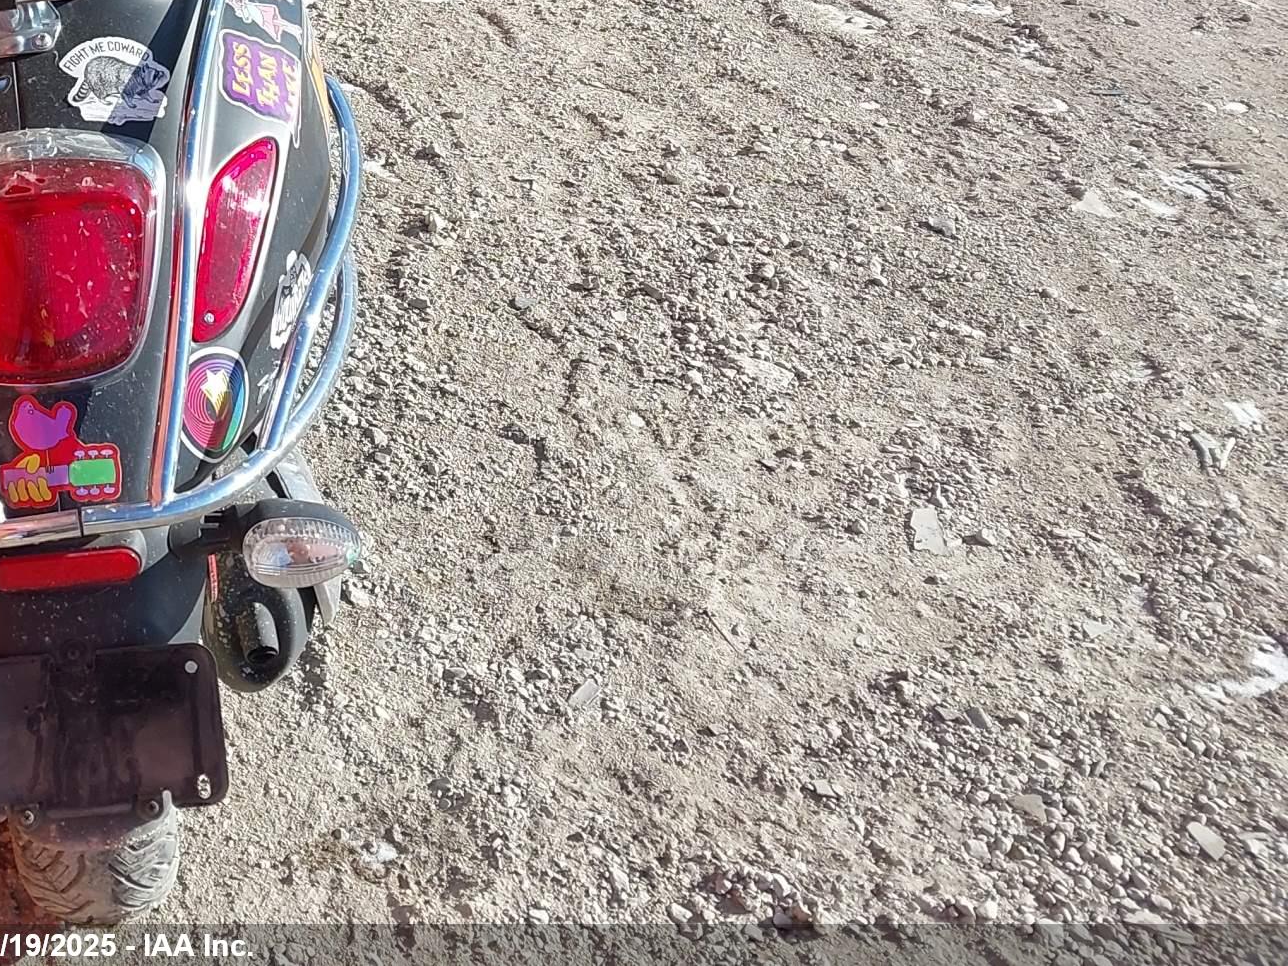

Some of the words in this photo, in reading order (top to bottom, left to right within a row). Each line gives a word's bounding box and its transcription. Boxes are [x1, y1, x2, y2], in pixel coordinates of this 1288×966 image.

[63, 47, 91, 72] FIGHT
[88, 41, 107, 56] ME
[107, 40, 150, 62] COWARD
[232, 41, 254, 97] LESS
[255, 50, 280, 108] THAN
